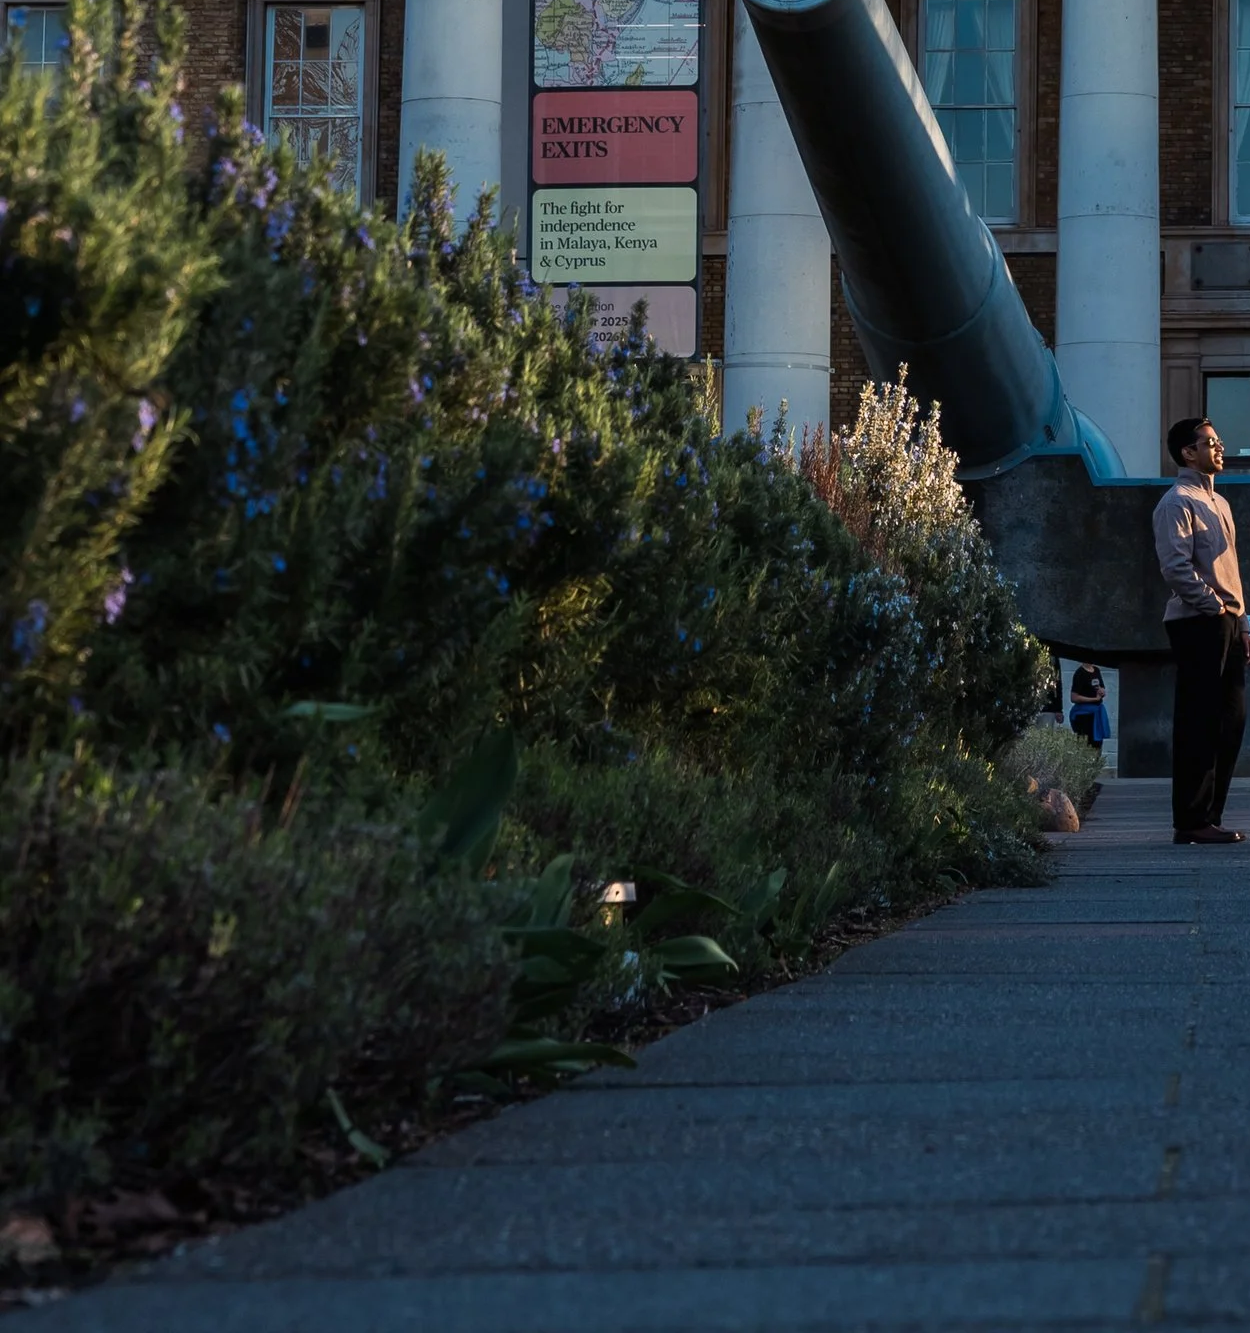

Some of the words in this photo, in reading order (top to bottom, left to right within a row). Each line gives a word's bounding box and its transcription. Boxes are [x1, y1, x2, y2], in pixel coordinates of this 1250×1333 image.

[541, 116, 685, 134] EMERGENCY
[541, 140, 608, 158] EXITS
[540, 202, 567, 215] The
[570, 201, 600, 217] fight
[604, 201, 624, 214] for
[540, 219, 636, 234] independence
[540, 237, 553, 250] in
[557, 236, 611, 252] Malaya,
[614, 236, 658, 251] Kenya
[539, 255, 552, 268] &
[555, 255, 606, 269] Cyprus
[601, 317, 628, 327] 2025
